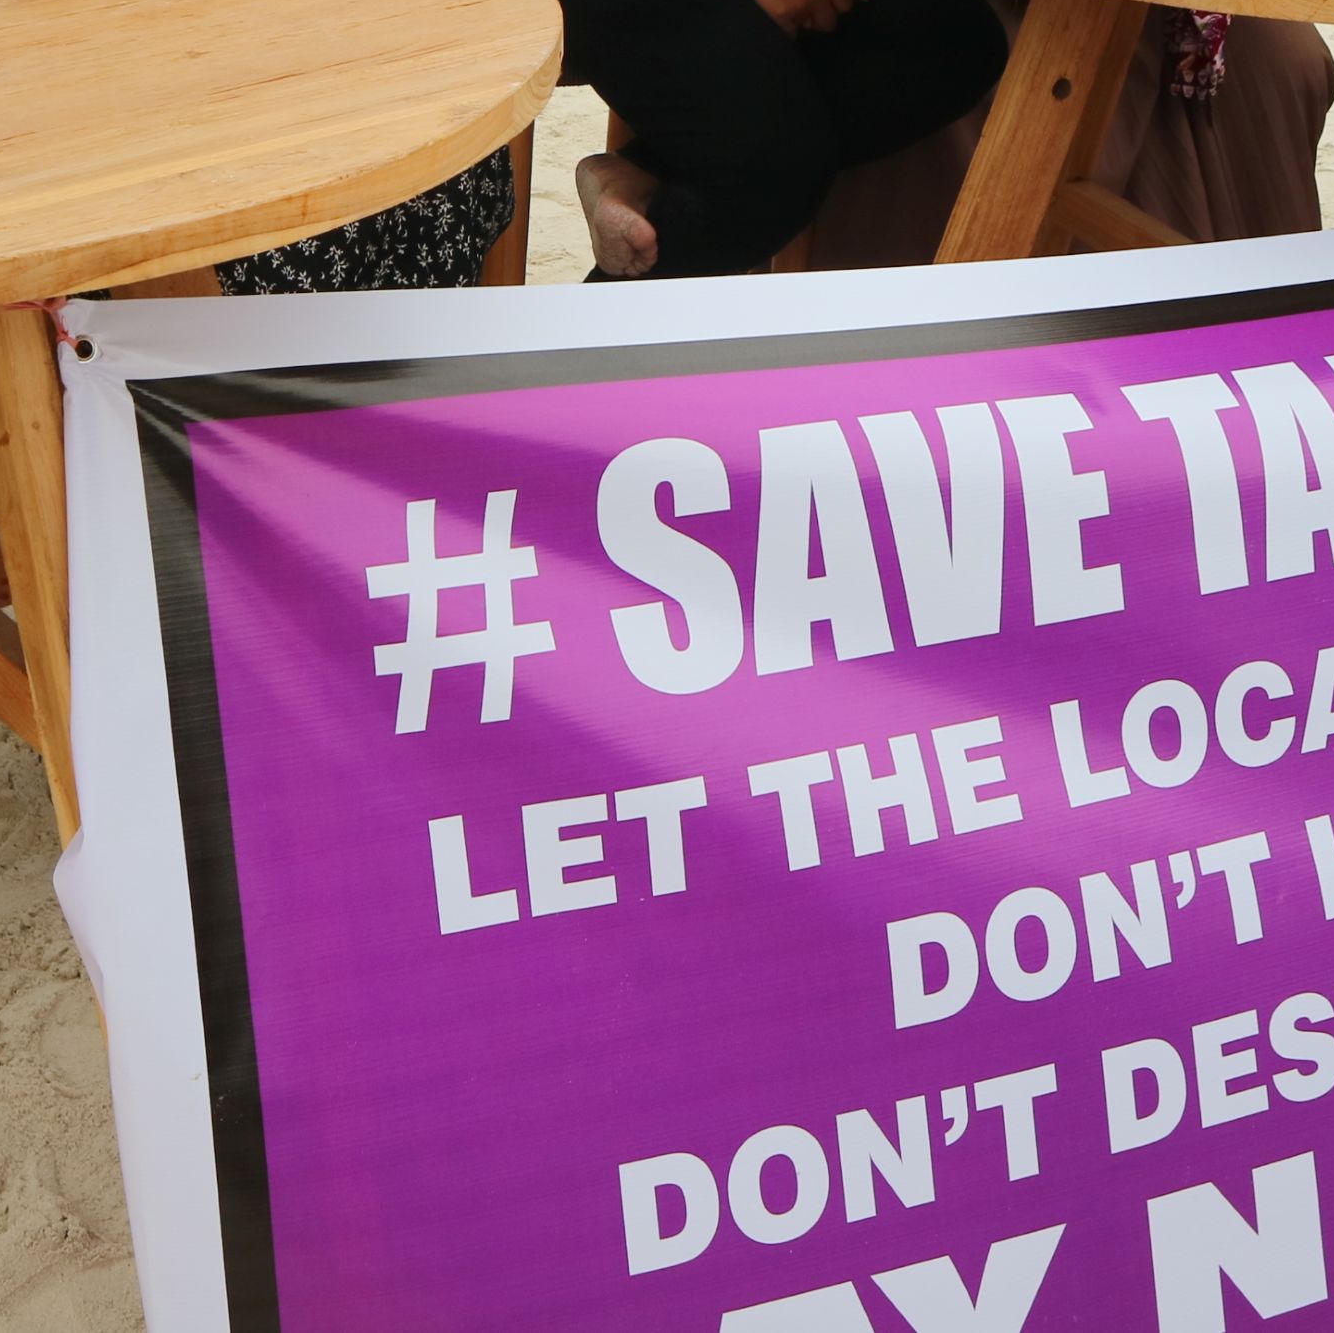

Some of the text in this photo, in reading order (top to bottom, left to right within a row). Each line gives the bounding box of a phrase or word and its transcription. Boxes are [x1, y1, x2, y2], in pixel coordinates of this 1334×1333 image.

[365, 489, 557, 734] #
[597, 393, 1125, 695] SAVE
[428, 776, 707, 935] LET
[747, 716, 1023, 871] THE
[887, 831, 1271, 1029] DON'T
[619, 1063, 1057, 1275] DON'T
